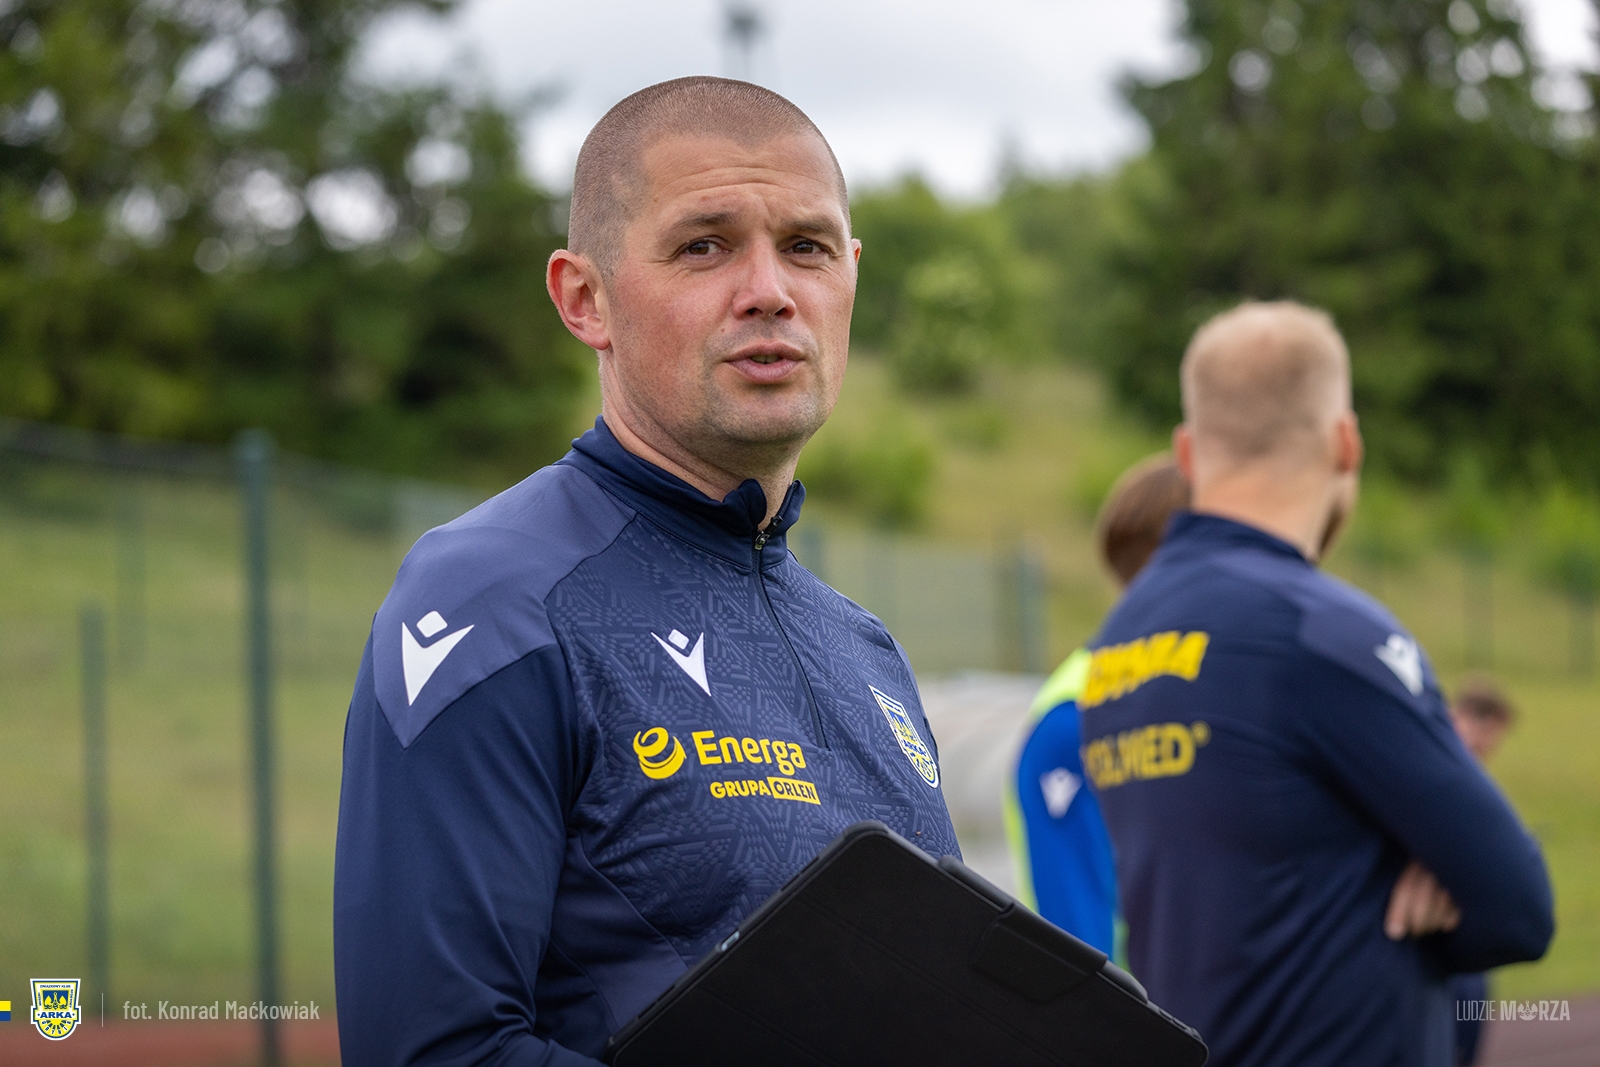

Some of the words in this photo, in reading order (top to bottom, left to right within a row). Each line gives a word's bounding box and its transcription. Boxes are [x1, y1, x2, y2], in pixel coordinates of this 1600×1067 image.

[692, 730, 807, 776] Energa
[710, 779, 769, 799] GRUPA
[771, 783, 817, 802] ORLEN
